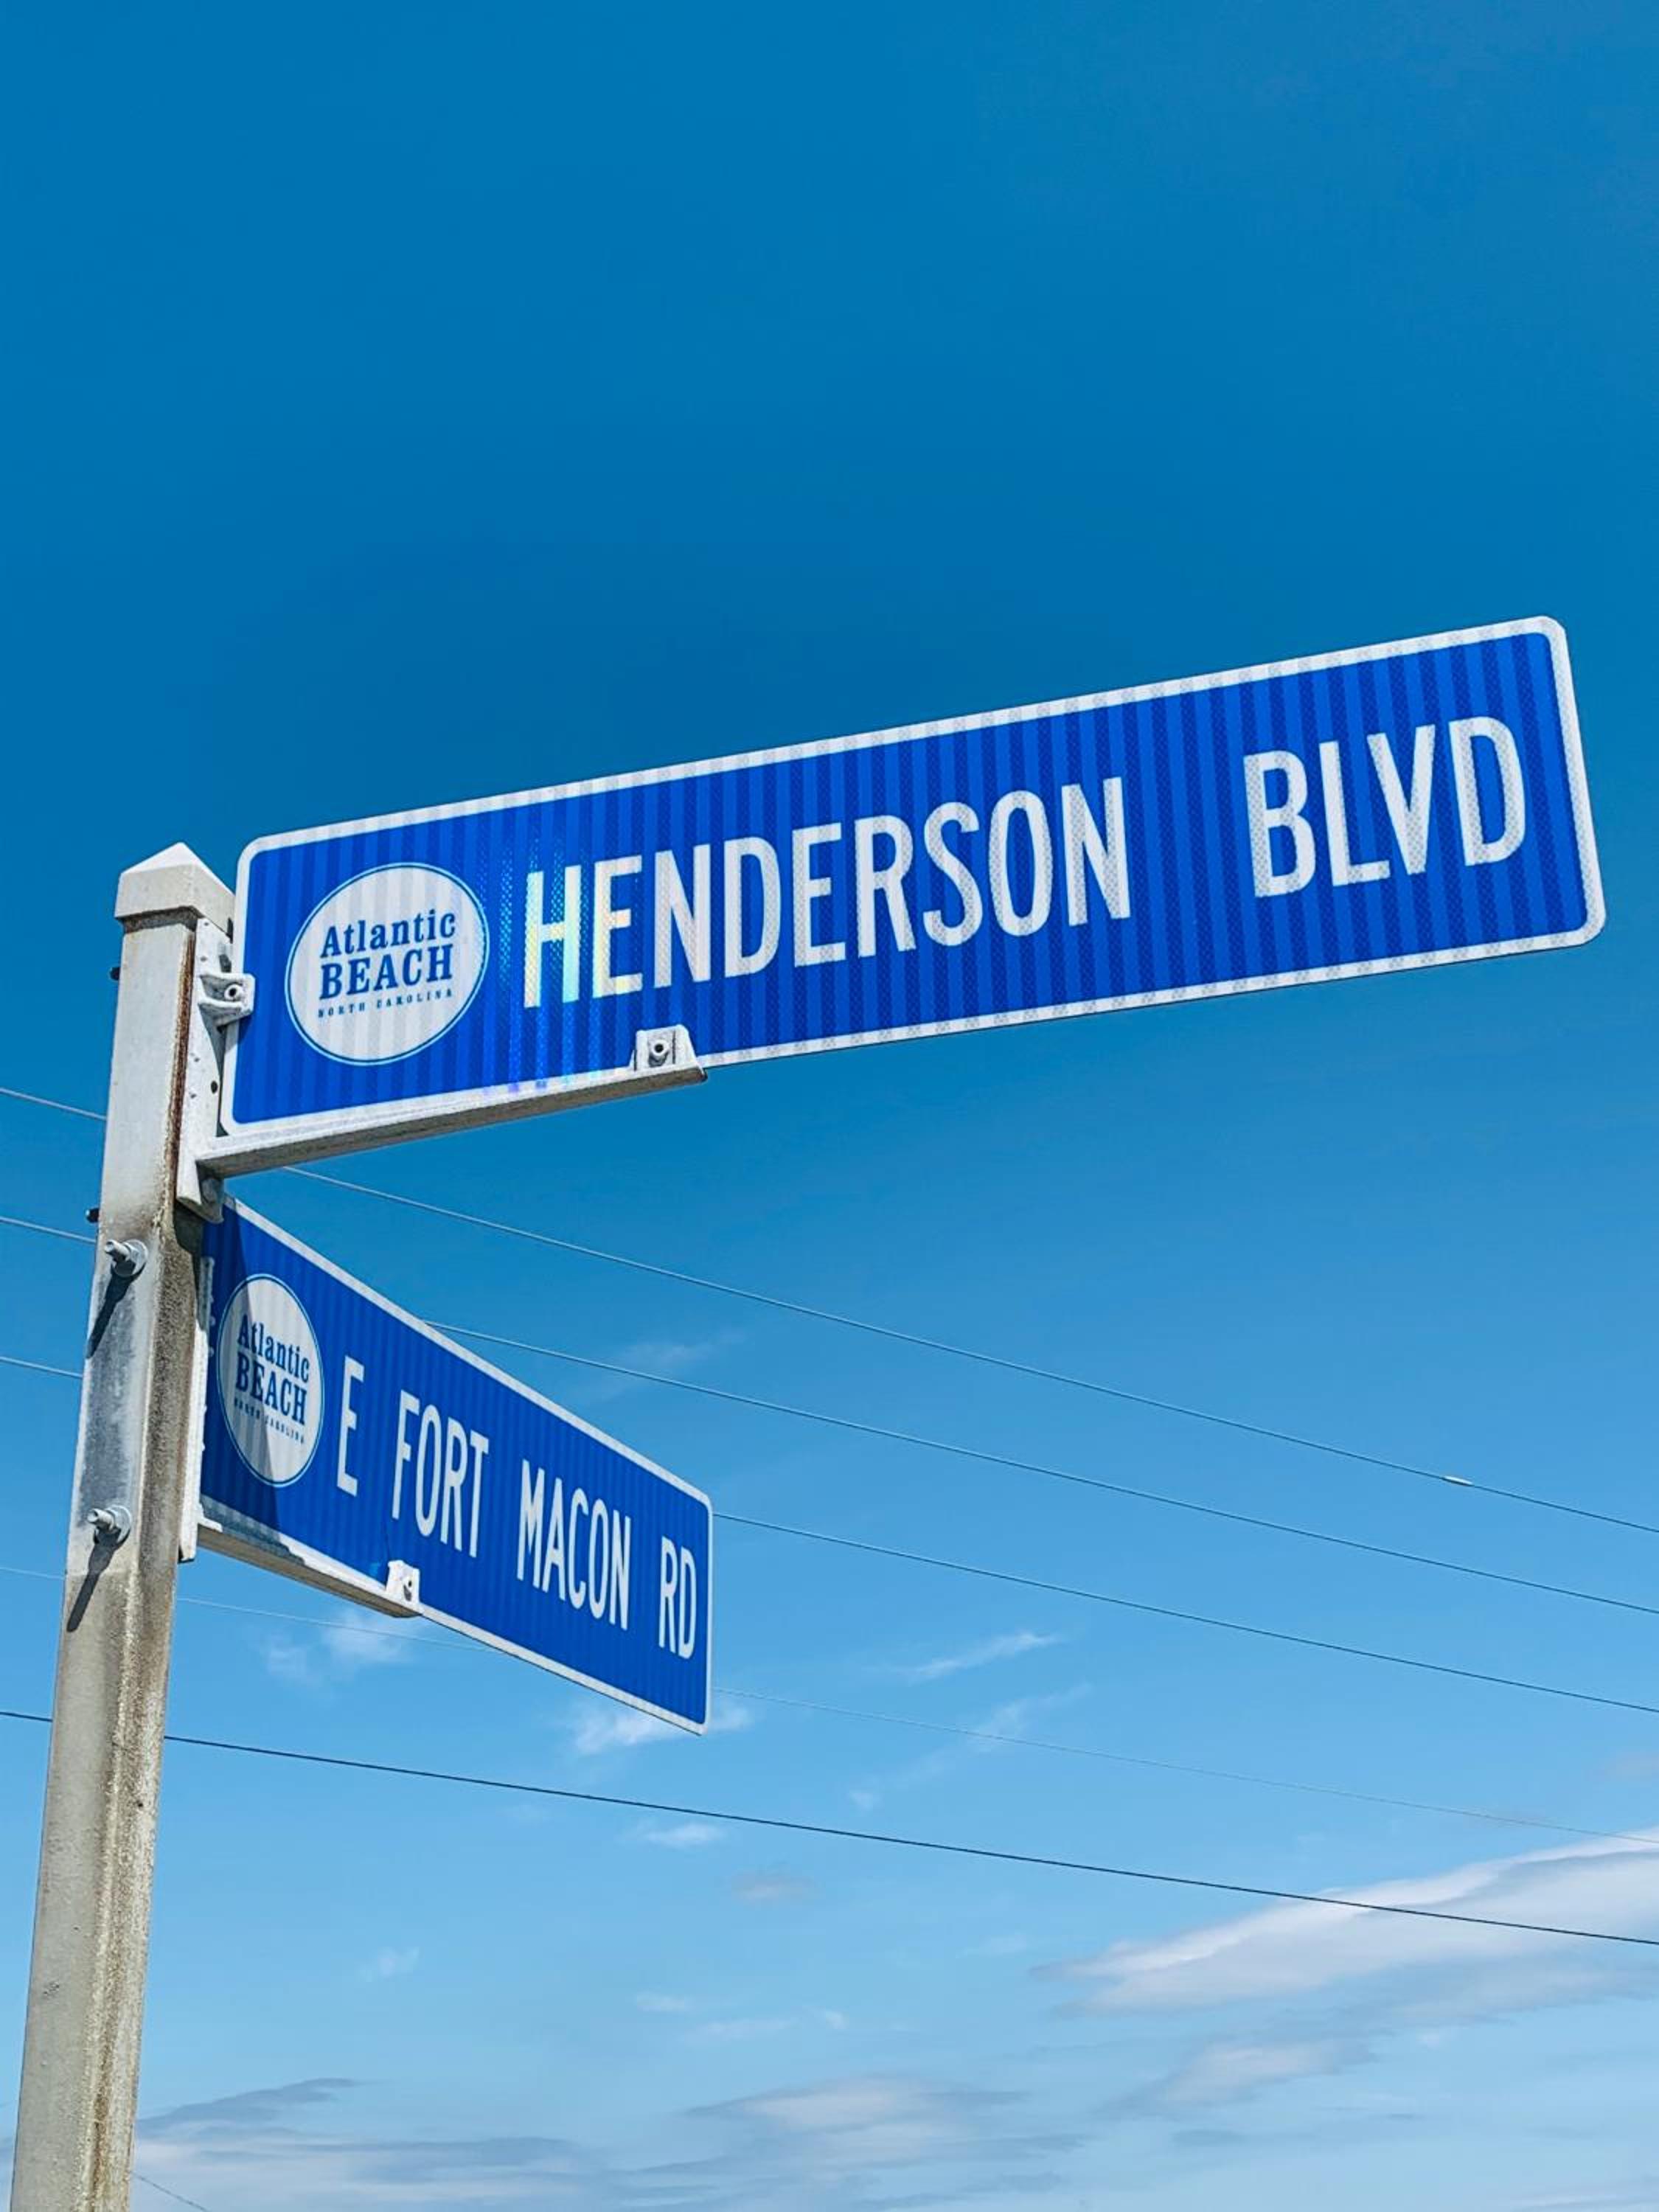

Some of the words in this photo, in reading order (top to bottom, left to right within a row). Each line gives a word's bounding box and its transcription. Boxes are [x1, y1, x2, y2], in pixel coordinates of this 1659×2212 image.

[524, 777, 1131, 1008] HENDERSON
[1244, 716, 1526, 897] BLVD
[320, 909, 456, 958] Atlantic
[318, 1002, 366, 1018] NORTH
[377, 989, 452, 1009] CAROLINA
[319, 944, 453, 1001] BEACH
[237, 1314, 310, 1384] Atlantic
[235, 1352, 307, 1426] BEACH
[337, 1355, 364, 1497] E
[392, 1389, 489, 1558] FORT
[516, 1459, 631, 1630] MACON
[658, 1536, 697, 1660] RD
